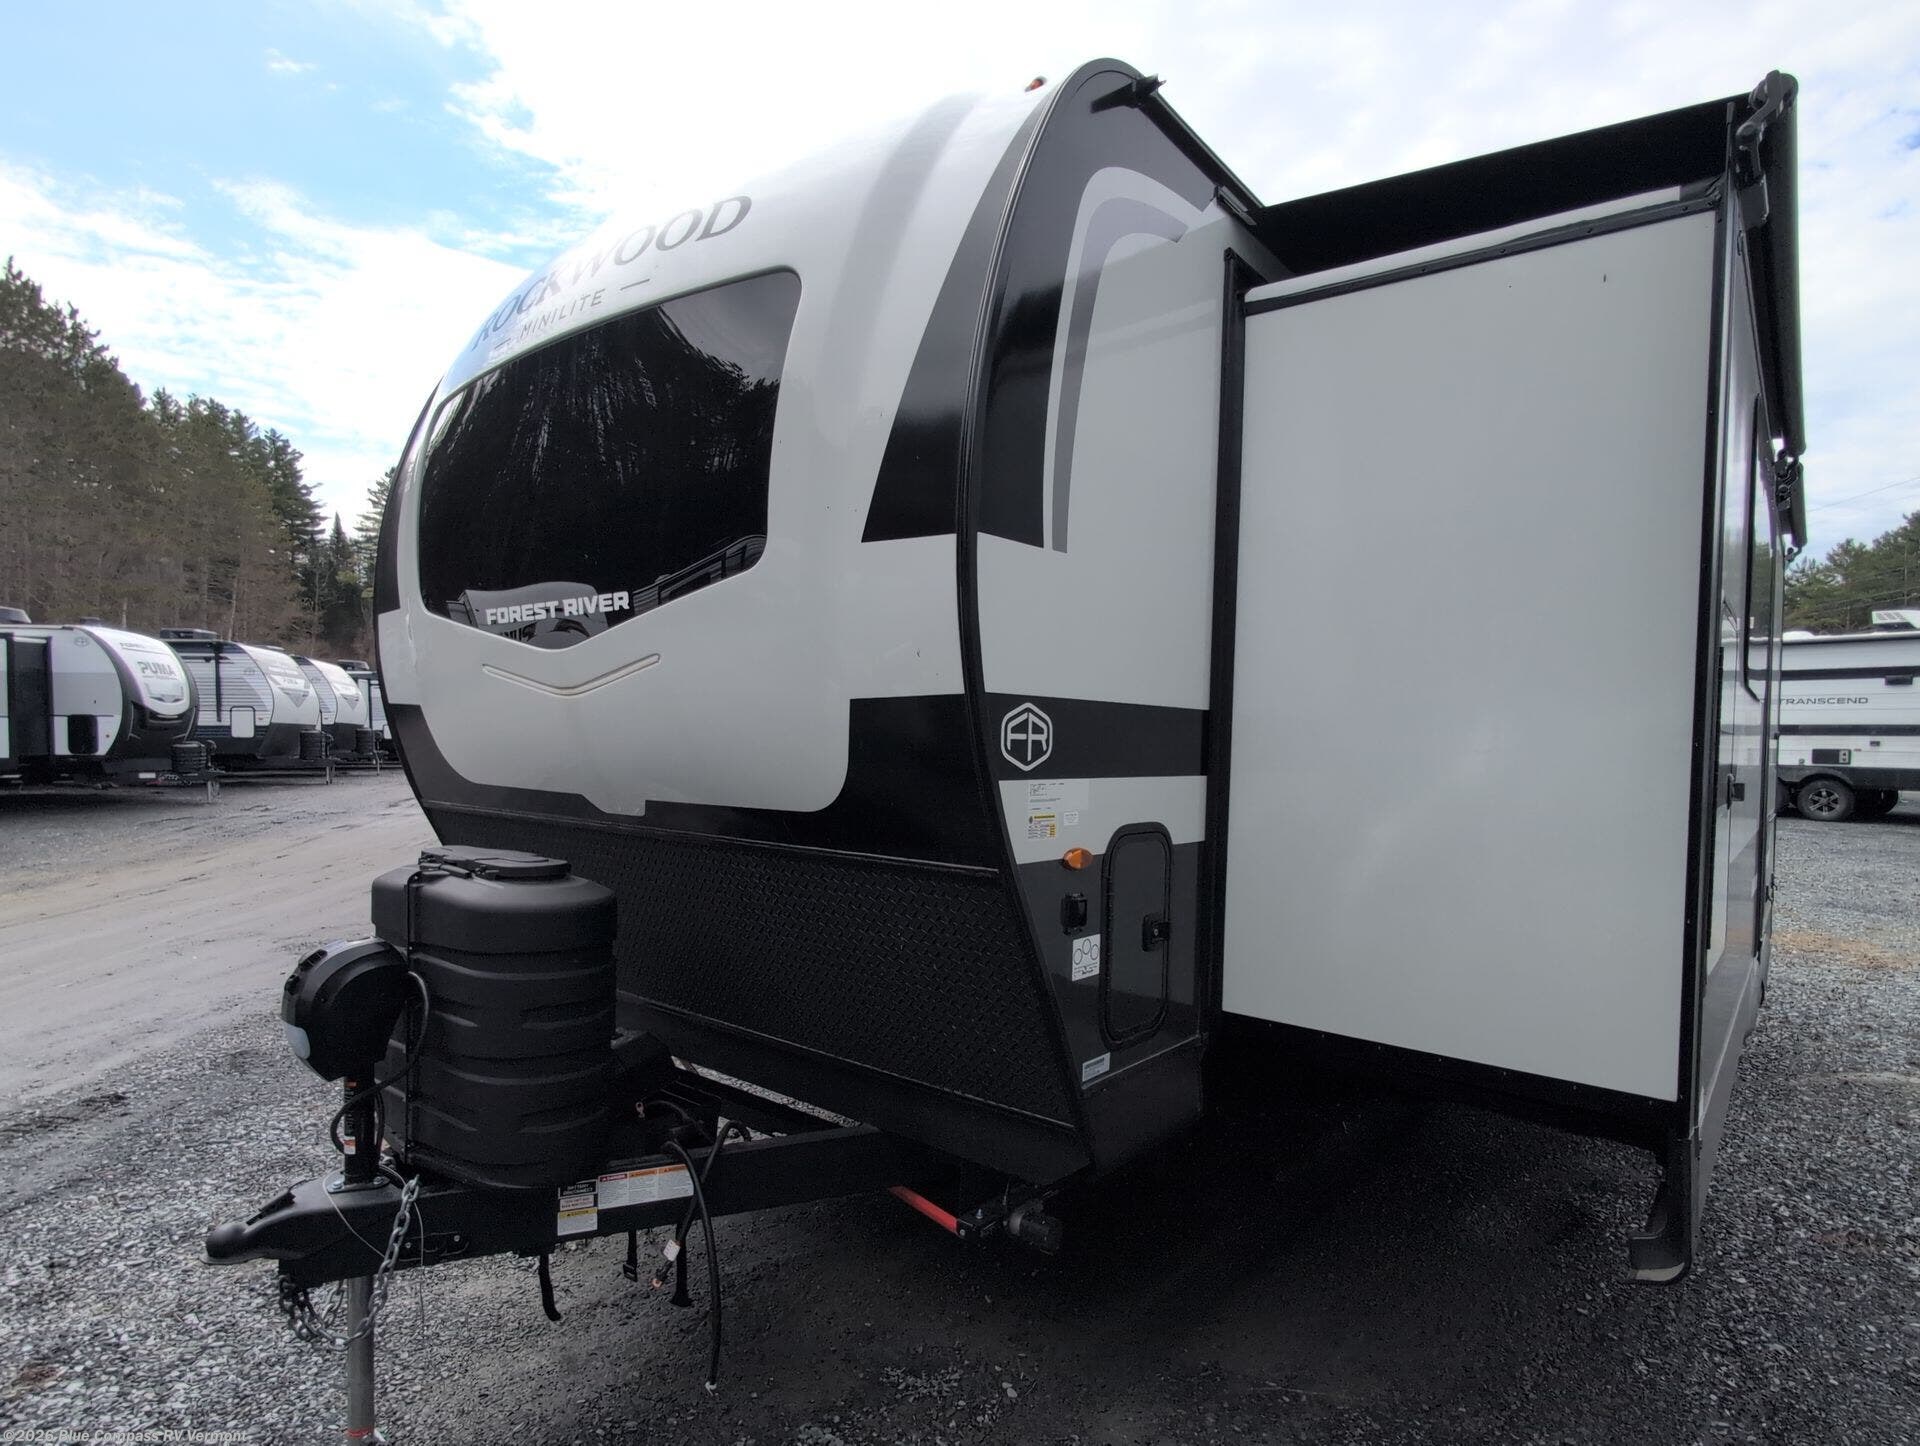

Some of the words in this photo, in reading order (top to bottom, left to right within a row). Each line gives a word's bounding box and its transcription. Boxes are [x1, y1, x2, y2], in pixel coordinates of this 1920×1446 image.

[472, 195, 752, 352] ROCKWOOD
[520, 288, 606, 340] MINILITE
[485, 600, 559, 625] FOREST
[562, 591, 630, 617] RIVER
[137, 661, 176, 677] PUMA
